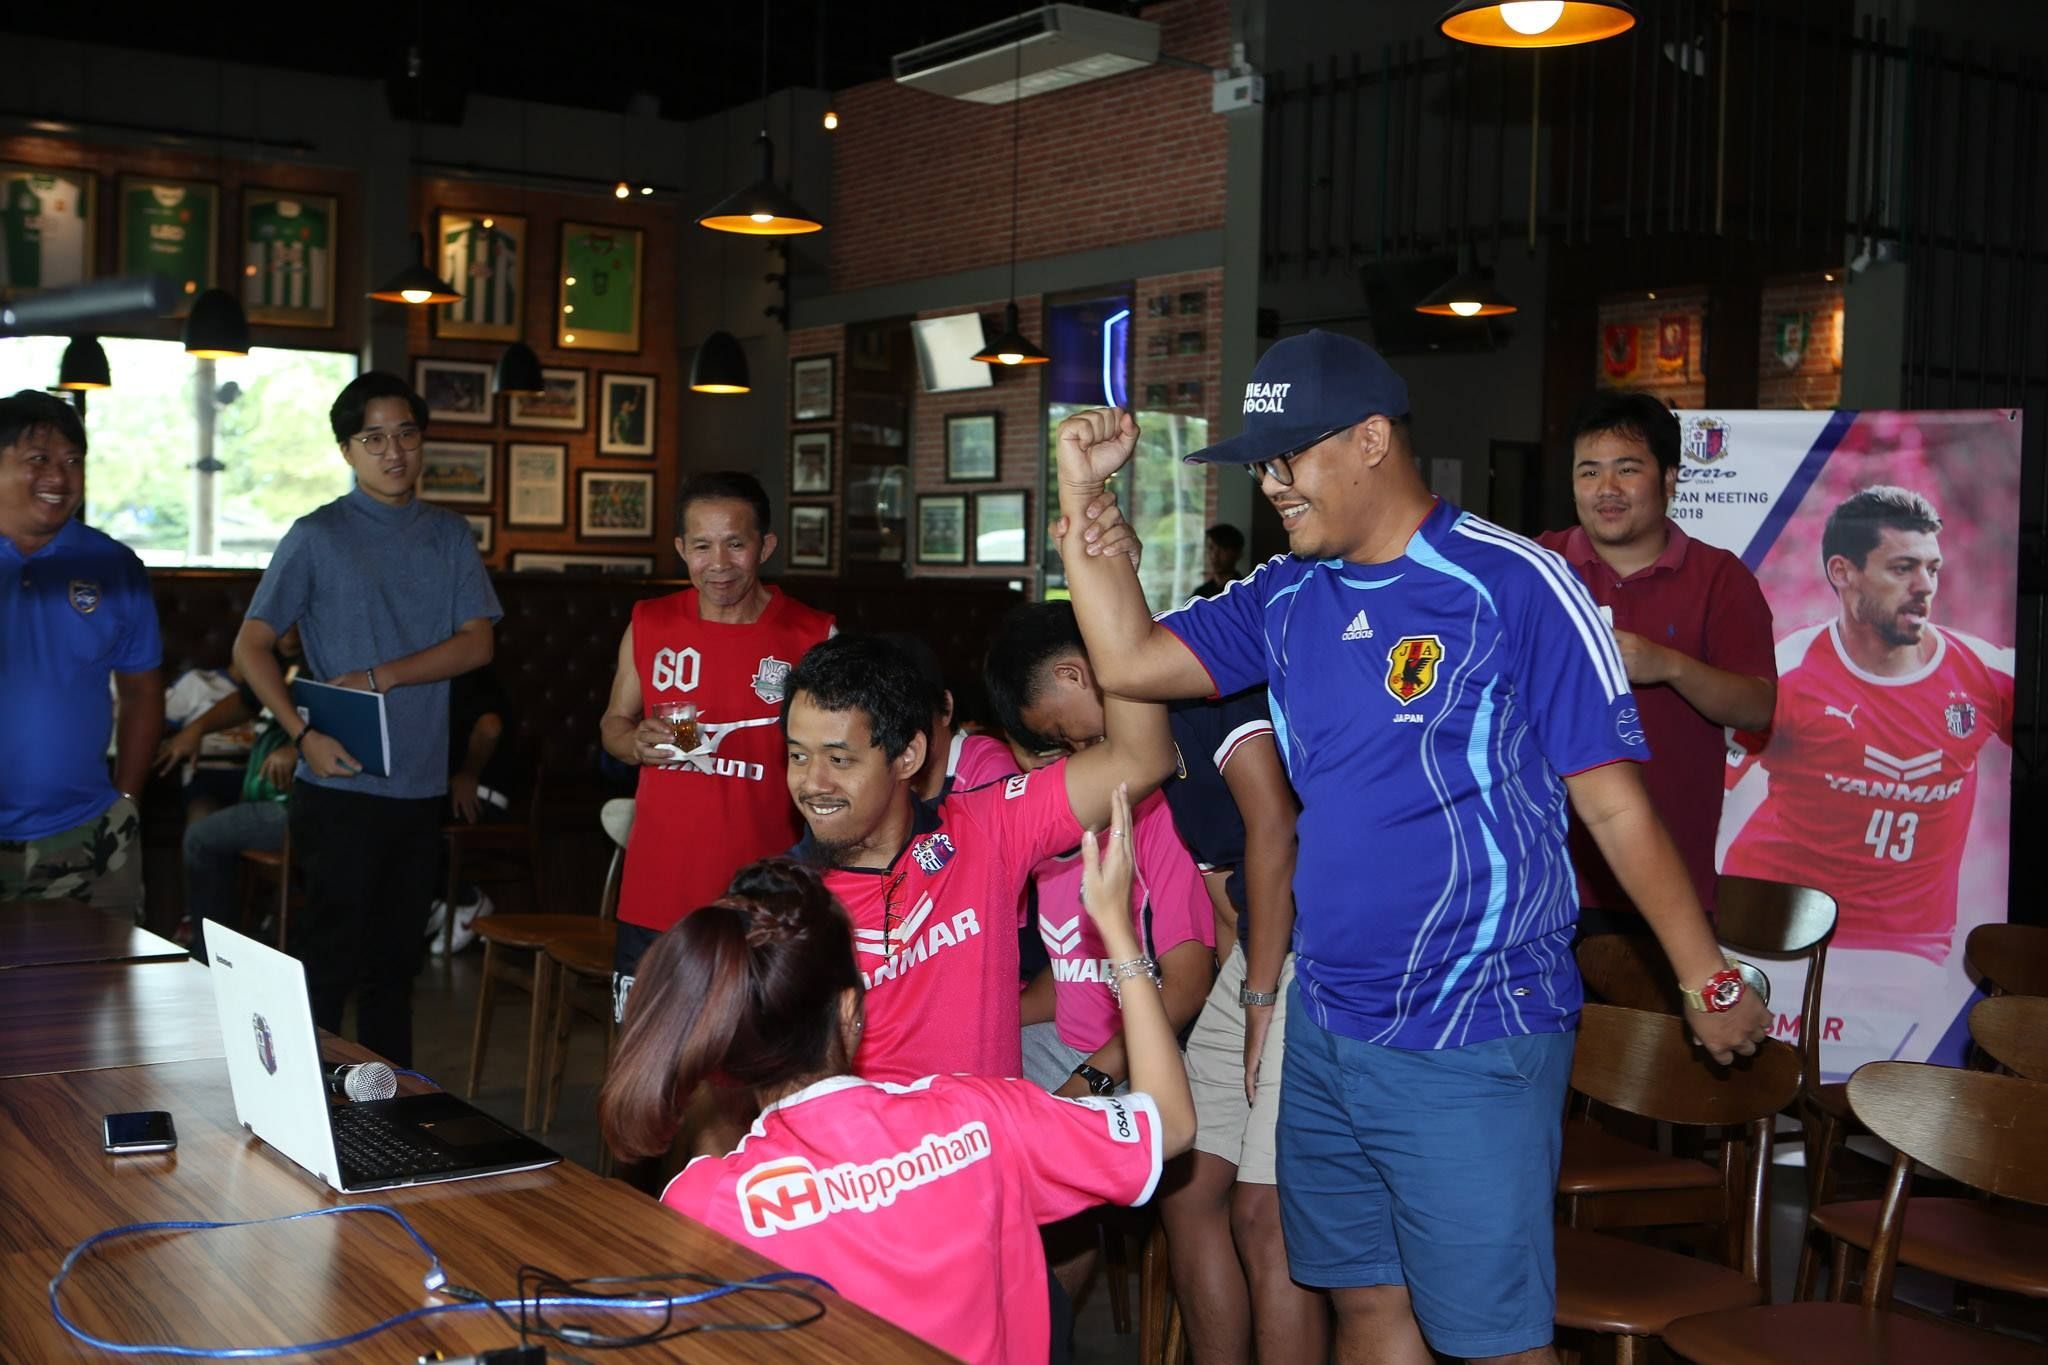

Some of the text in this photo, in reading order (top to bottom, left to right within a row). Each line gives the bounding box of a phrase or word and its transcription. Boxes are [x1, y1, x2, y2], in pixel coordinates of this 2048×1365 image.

[1245, 382, 1291, 399] HEART
[1672, 492, 1769, 504] FAN MEETING
[1671, 508, 1704, 519] 2018
[1341, 629, 1374, 641] adidas
[652, 647, 701, 692] 60
[1392, 713, 1424, 723] JAPAN
[1824, 773, 1964, 804] YANMAR
[1864, 808, 1919, 862] 43
[824, 1128, 988, 1206] Nipponham
